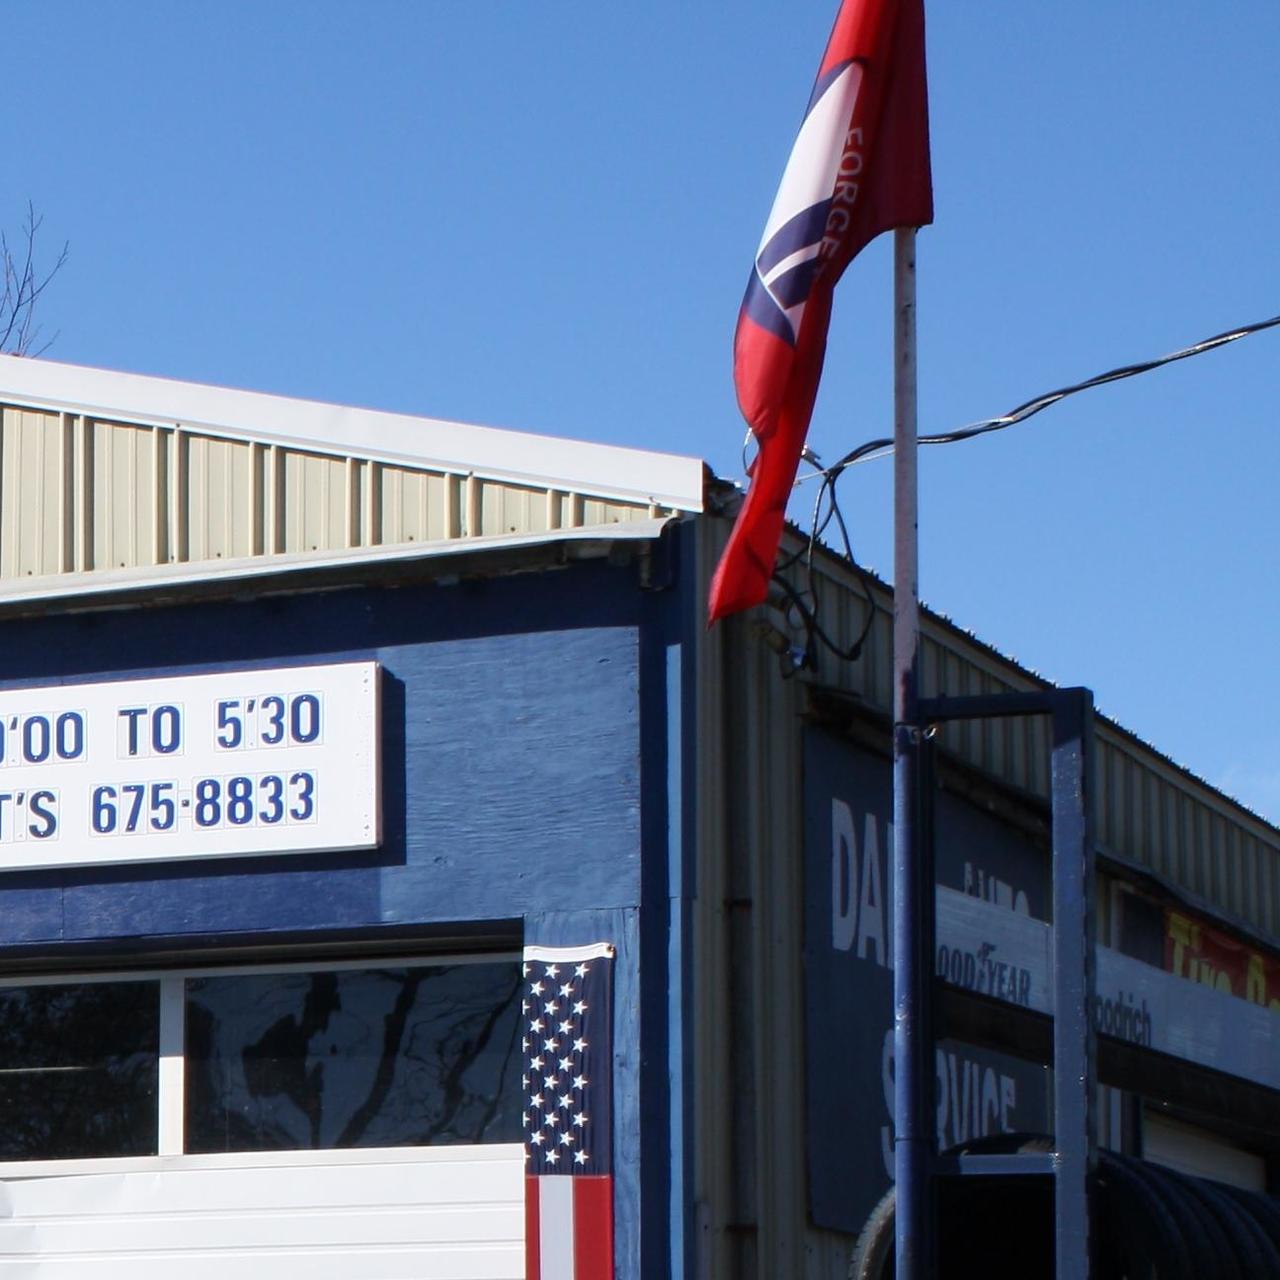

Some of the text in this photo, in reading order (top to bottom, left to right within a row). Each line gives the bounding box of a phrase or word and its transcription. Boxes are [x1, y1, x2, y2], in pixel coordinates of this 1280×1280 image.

[118, 704, 180, 756] TO
[831, 799, 894, 968] DA
[938, 944, 1031, 1006] OODYEAR
[1092, 991, 1151, 1048] oodrich
[881, 1029, 1016, 1179] SRVICE
